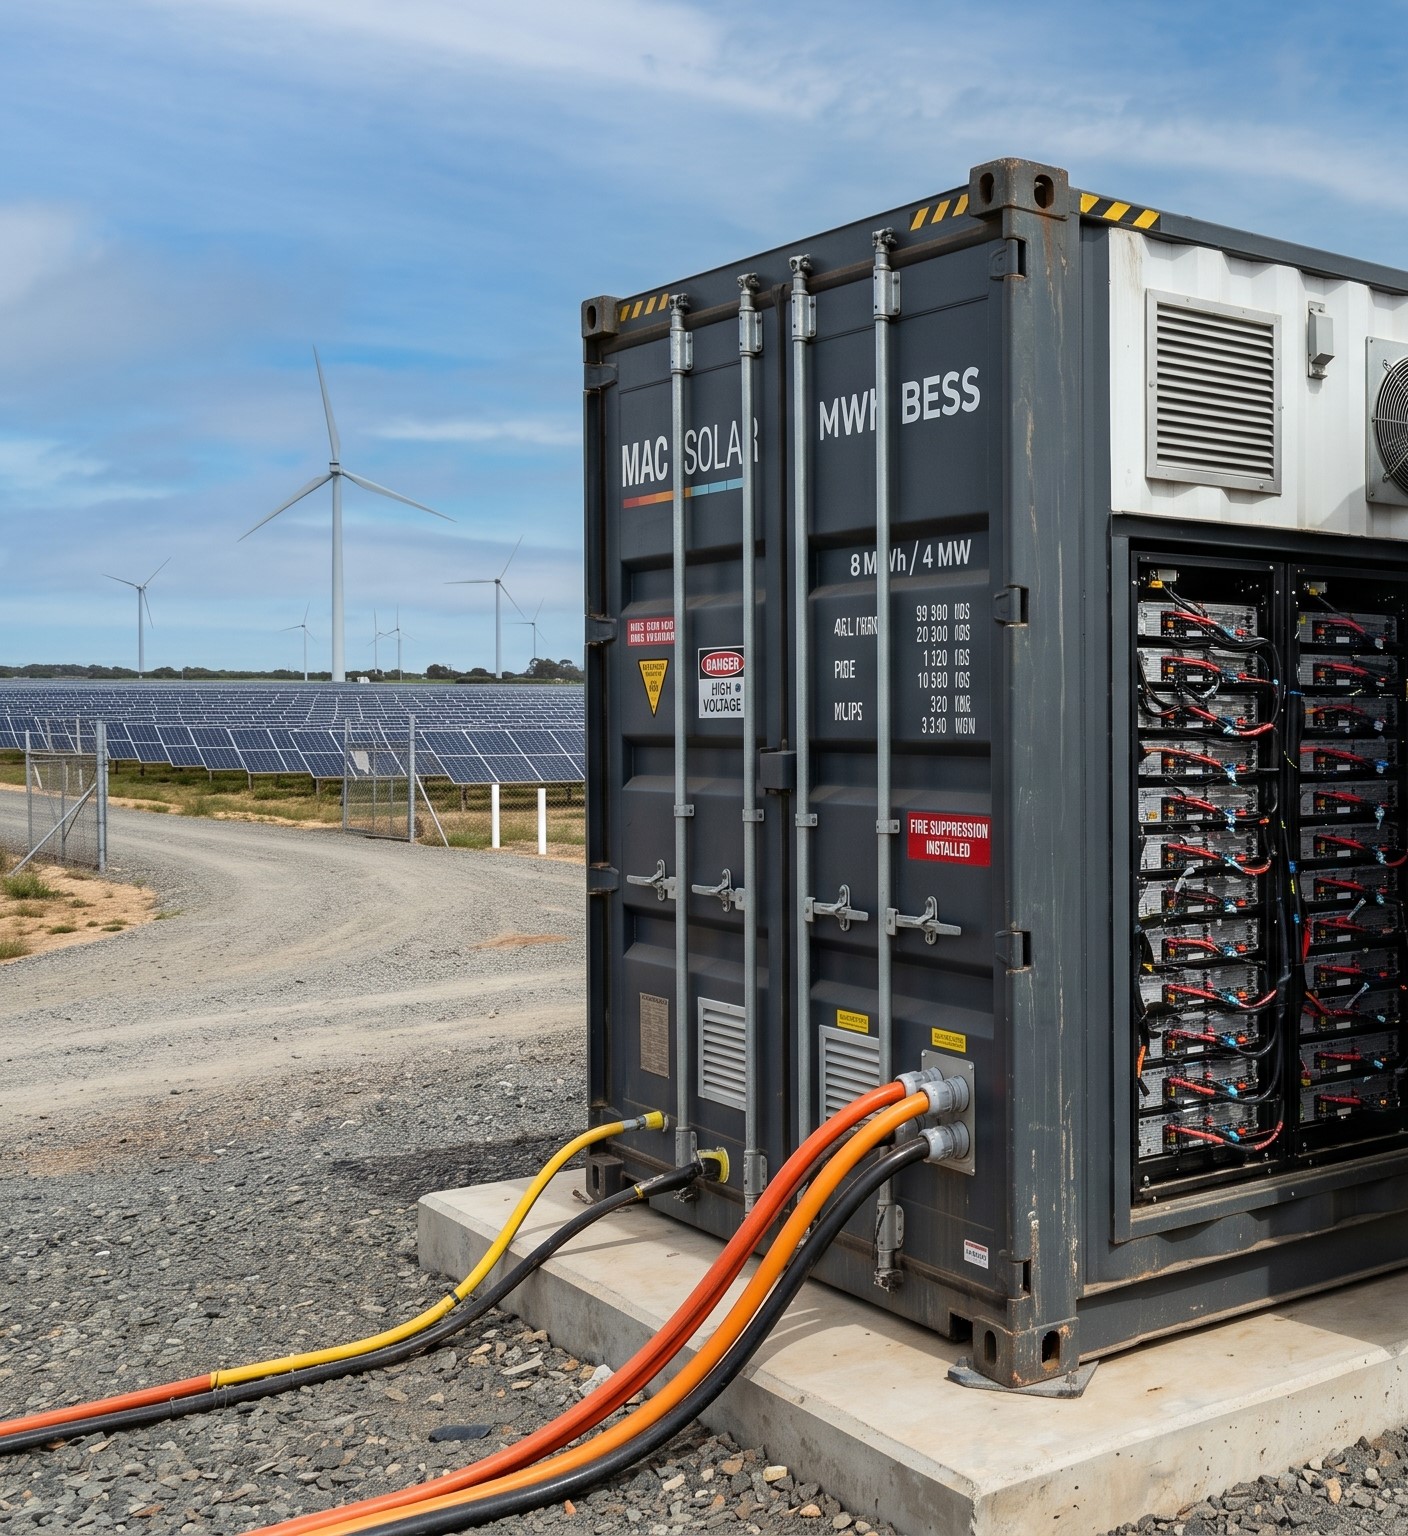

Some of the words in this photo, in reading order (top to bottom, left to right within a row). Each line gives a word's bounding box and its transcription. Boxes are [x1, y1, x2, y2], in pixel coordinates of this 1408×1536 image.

[902, 366, 981, 425] BESS
[622, 435, 668, 488] MAC
[850, 553, 860, 577] 8
[922, 544, 933, 569] 4
[938, 539, 972, 568] MW
[916, 605, 928, 622] 99
[916, 626, 929, 643] 20
[931, 625, 948, 642] 300
[711, 682, 732, 696] HIGH
[703, 698, 741, 712] VOLTAGE
[930, 695, 948, 713] 320
[910, 819, 929, 835] FIRE
[930, 820, 988, 839] SUPPRESSION
[926, 839, 971, 858] INSTALLED
